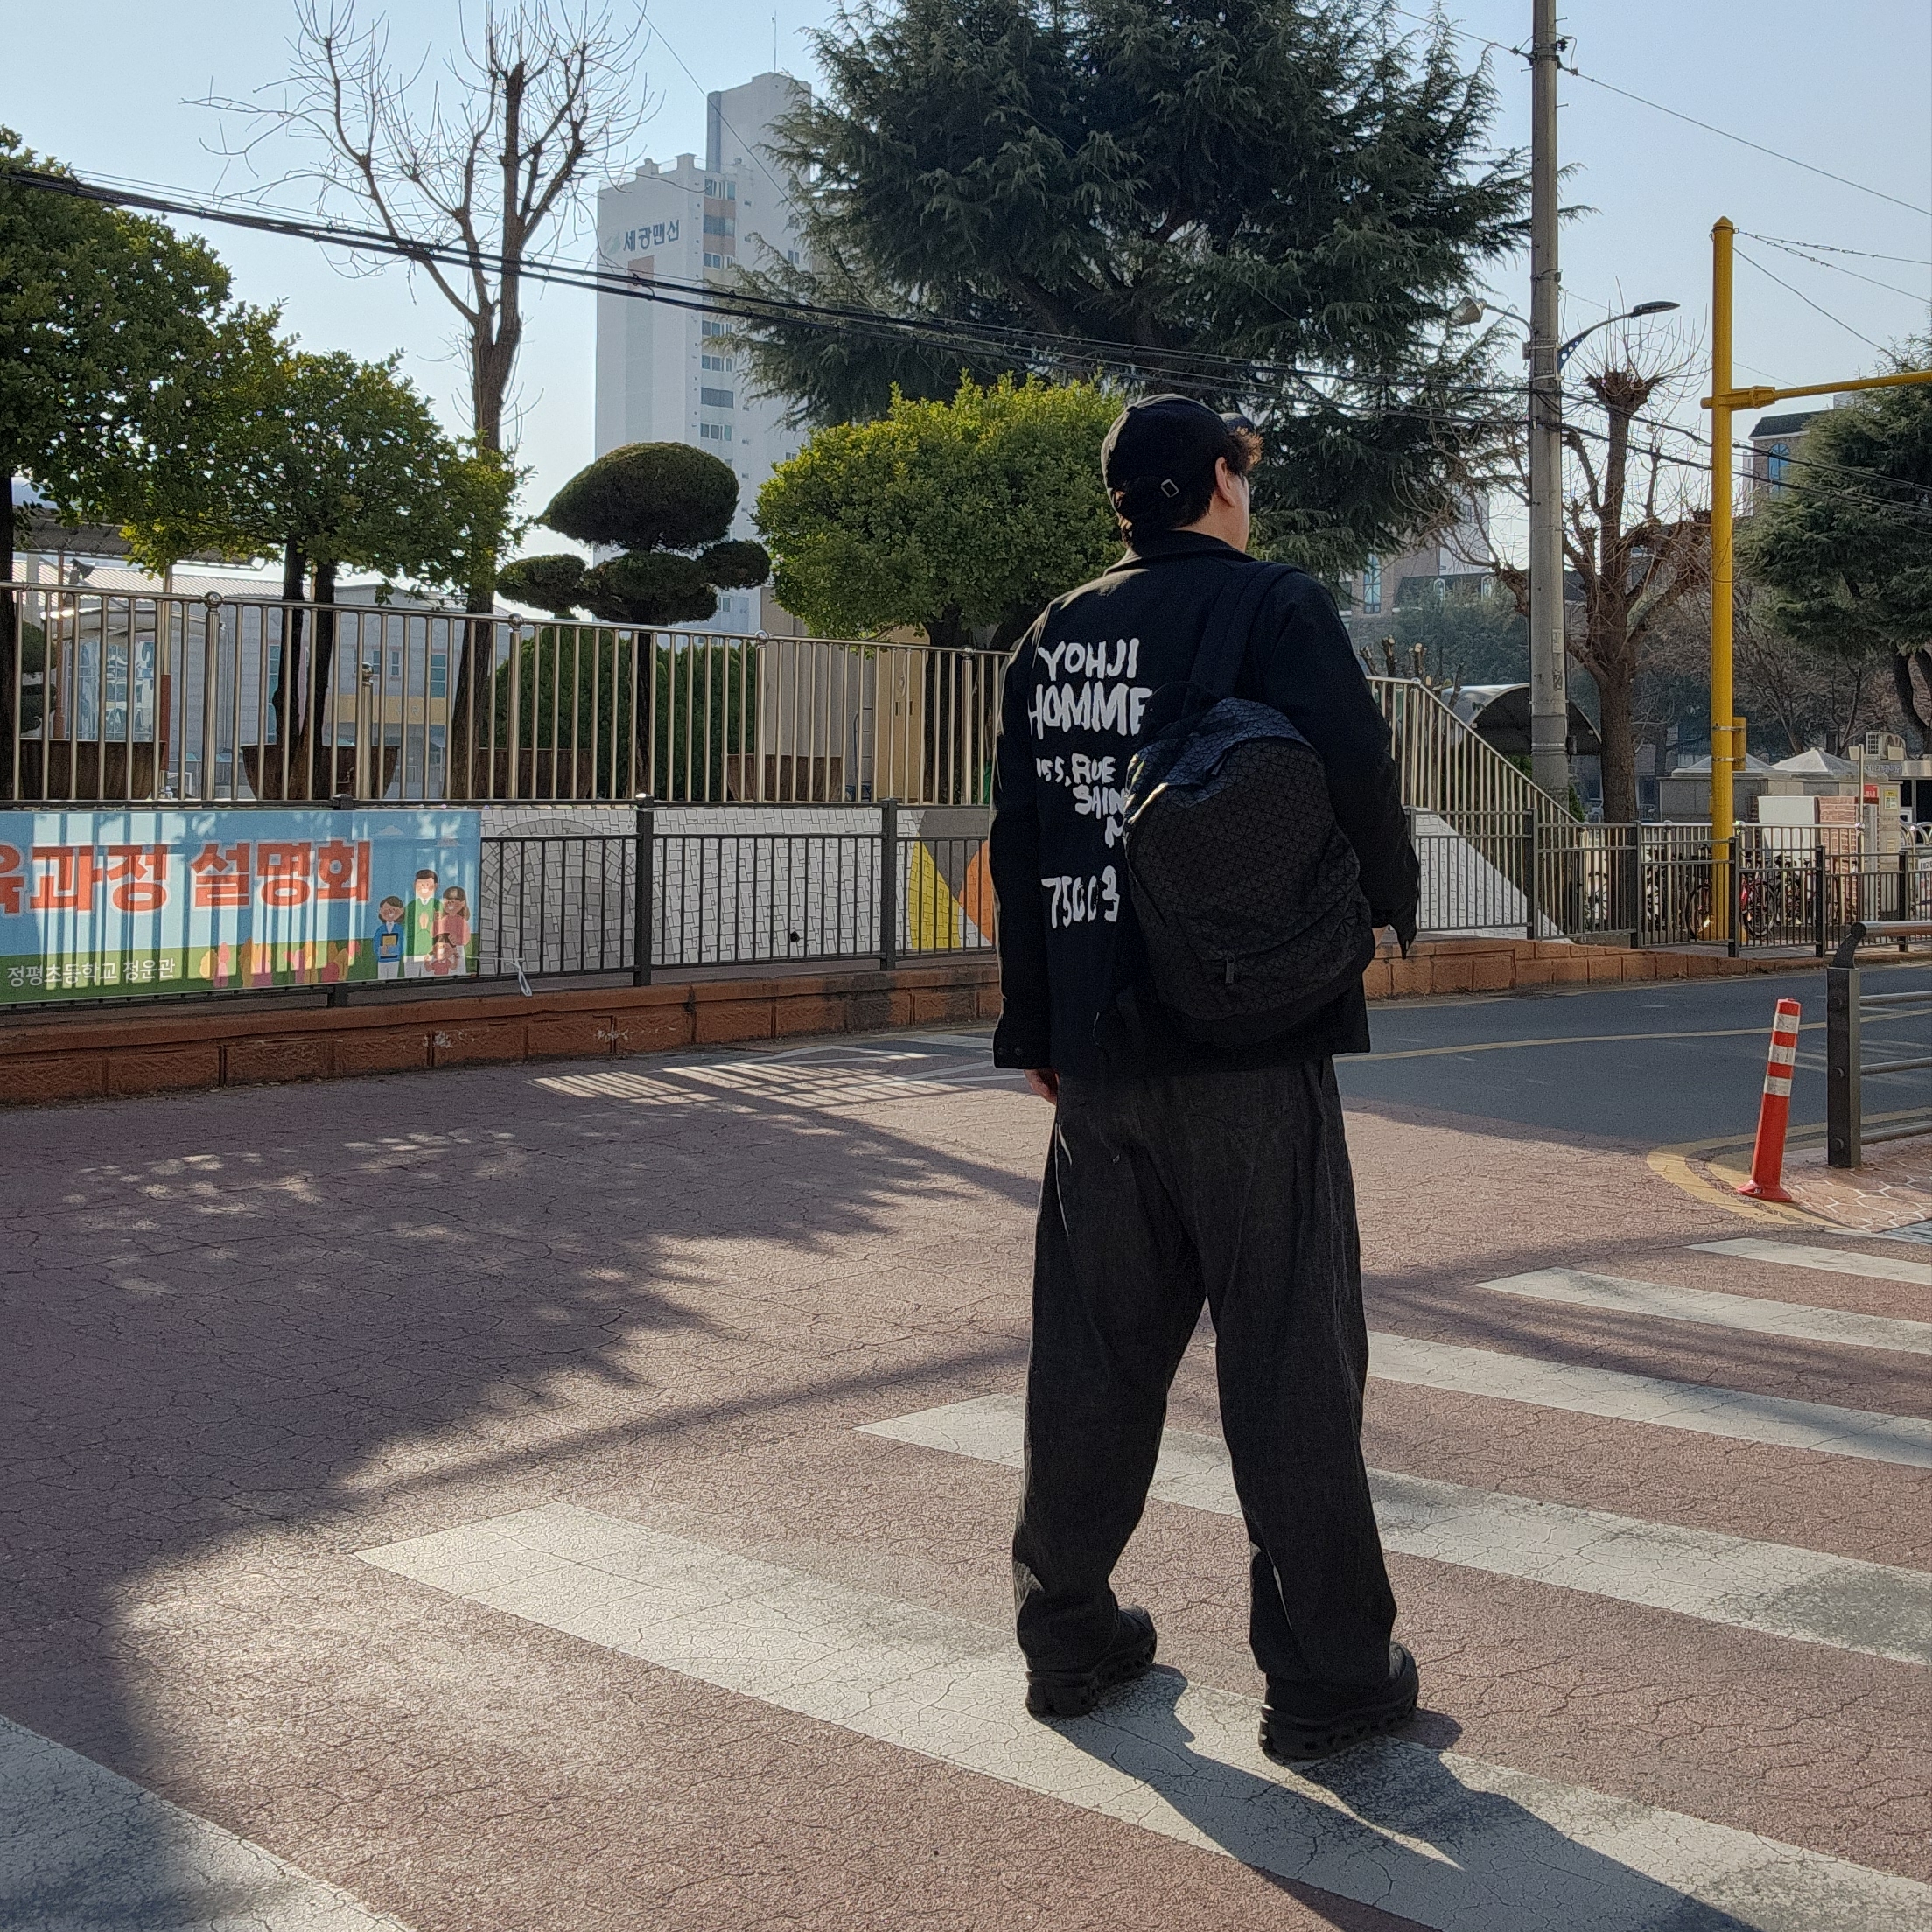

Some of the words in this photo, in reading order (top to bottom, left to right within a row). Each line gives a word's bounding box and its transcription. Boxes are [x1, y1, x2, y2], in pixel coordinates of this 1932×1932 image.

[1038, 638, 1139, 681] YOHJI
[191, 840, 371, 906] 설명회
[7, 962, 118, 987] 정평초등학교
